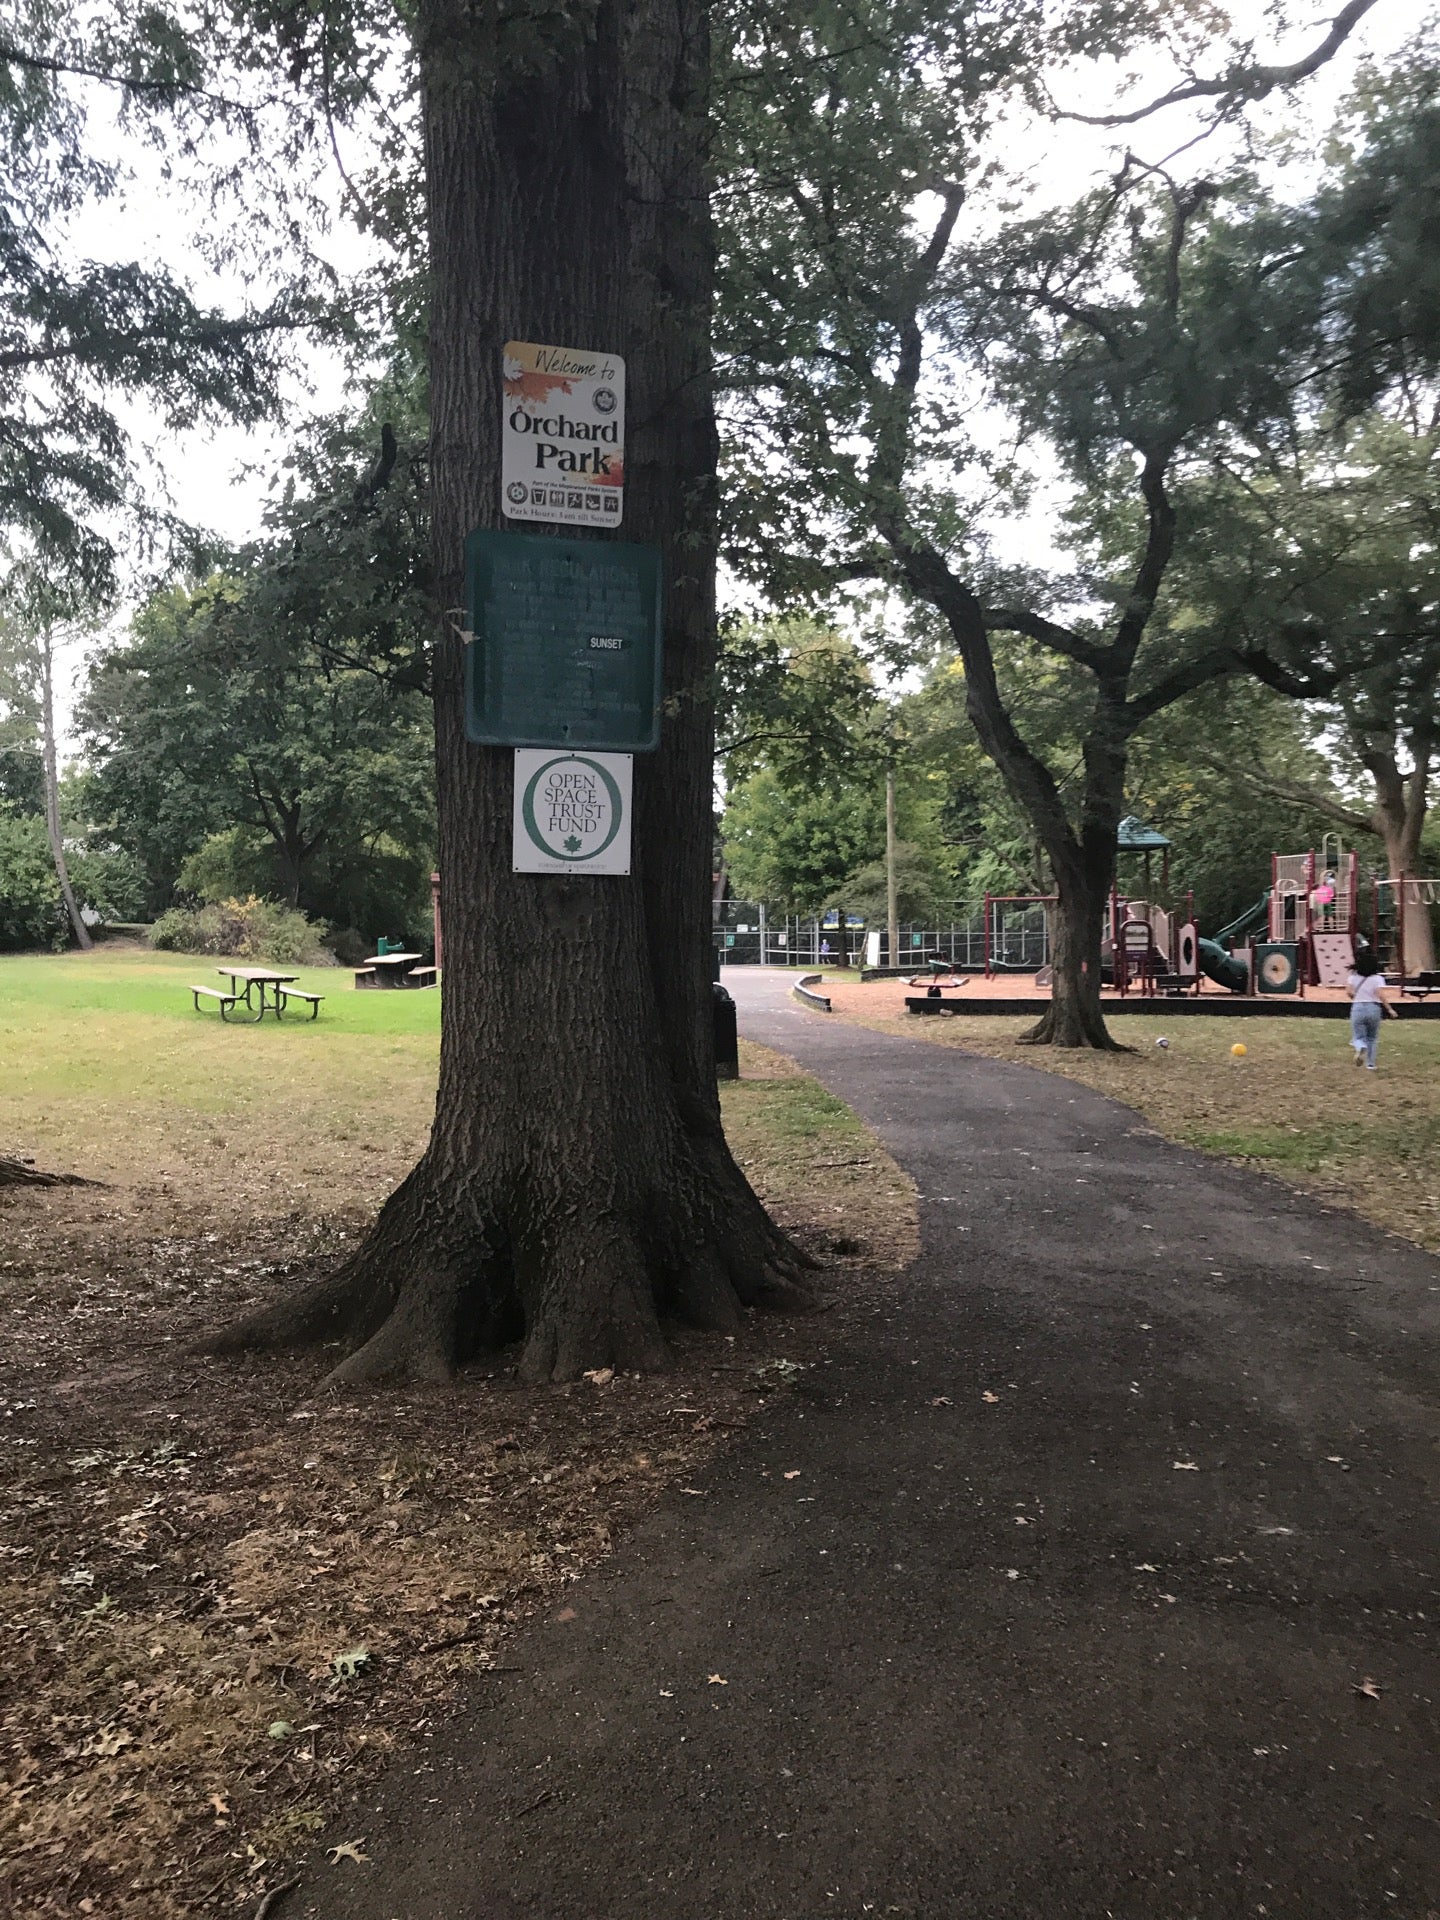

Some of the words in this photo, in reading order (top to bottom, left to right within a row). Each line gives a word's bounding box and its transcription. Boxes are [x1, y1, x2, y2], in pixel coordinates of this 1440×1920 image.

[535, 349, 598, 376] Welcome
[600, 361, 615, 380] to
[509, 410, 618, 443] Orchard
[535, 443, 611, 475] Park
[510, 507, 528, 515] Park
[590, 636, 623, 650] SUNSET
[549, 773, 596, 789] OPEN
[544, 787, 597, 804] SPACE
[548, 802, 606, 819] TRUST
[548, 818, 597, 833] FUND
